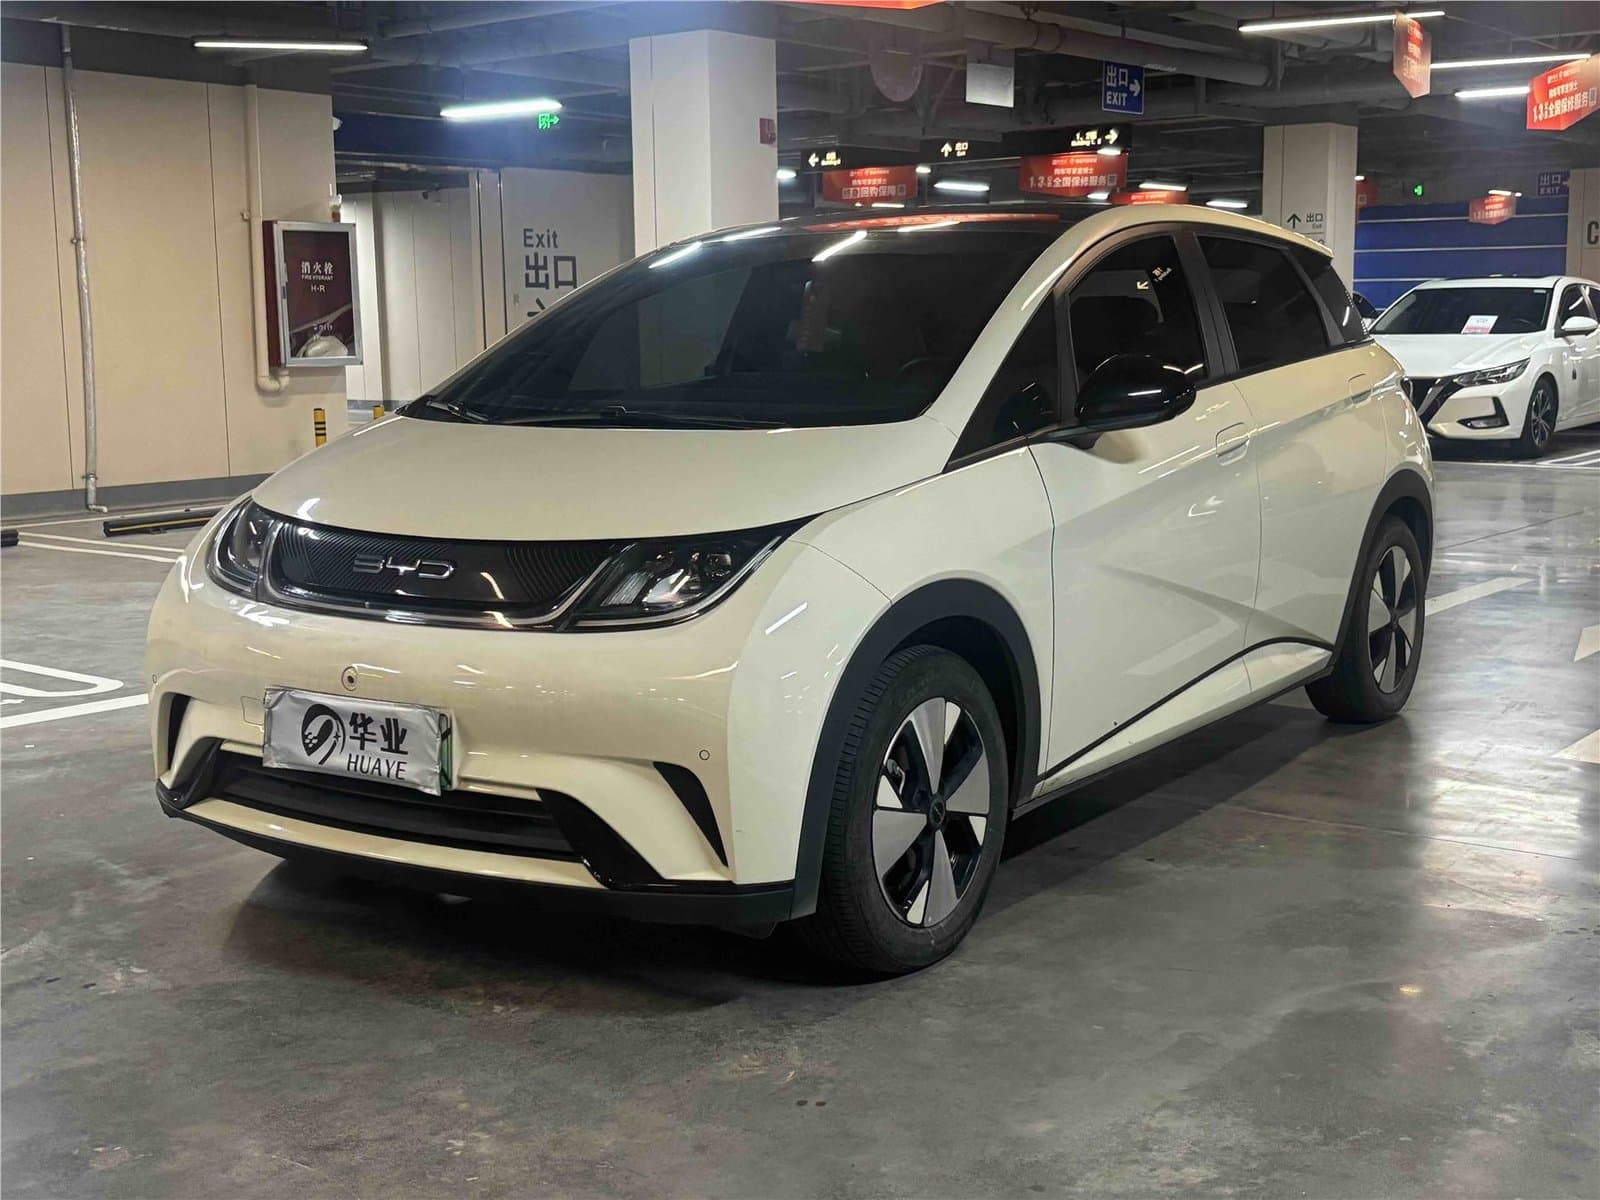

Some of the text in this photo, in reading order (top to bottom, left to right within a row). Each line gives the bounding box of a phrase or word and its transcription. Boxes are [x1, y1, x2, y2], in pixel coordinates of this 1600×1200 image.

[1106, 64, 1128, 87] 出口
[1106, 91, 1127, 106] EXIT
[1540, 174, 1561, 185] 出口
[1306, 212, 1324, 222] 出口
[523, 228, 558, 248] Exit
[301, 261, 334, 275] 消火栓
[525, 252, 578, 289] 出口
[310, 284, 326, 293] H-R
[353, 553, 455, 579] BYD
[348, 711, 409, 755] 华业
[347, 753, 408, 780] HUAYE
